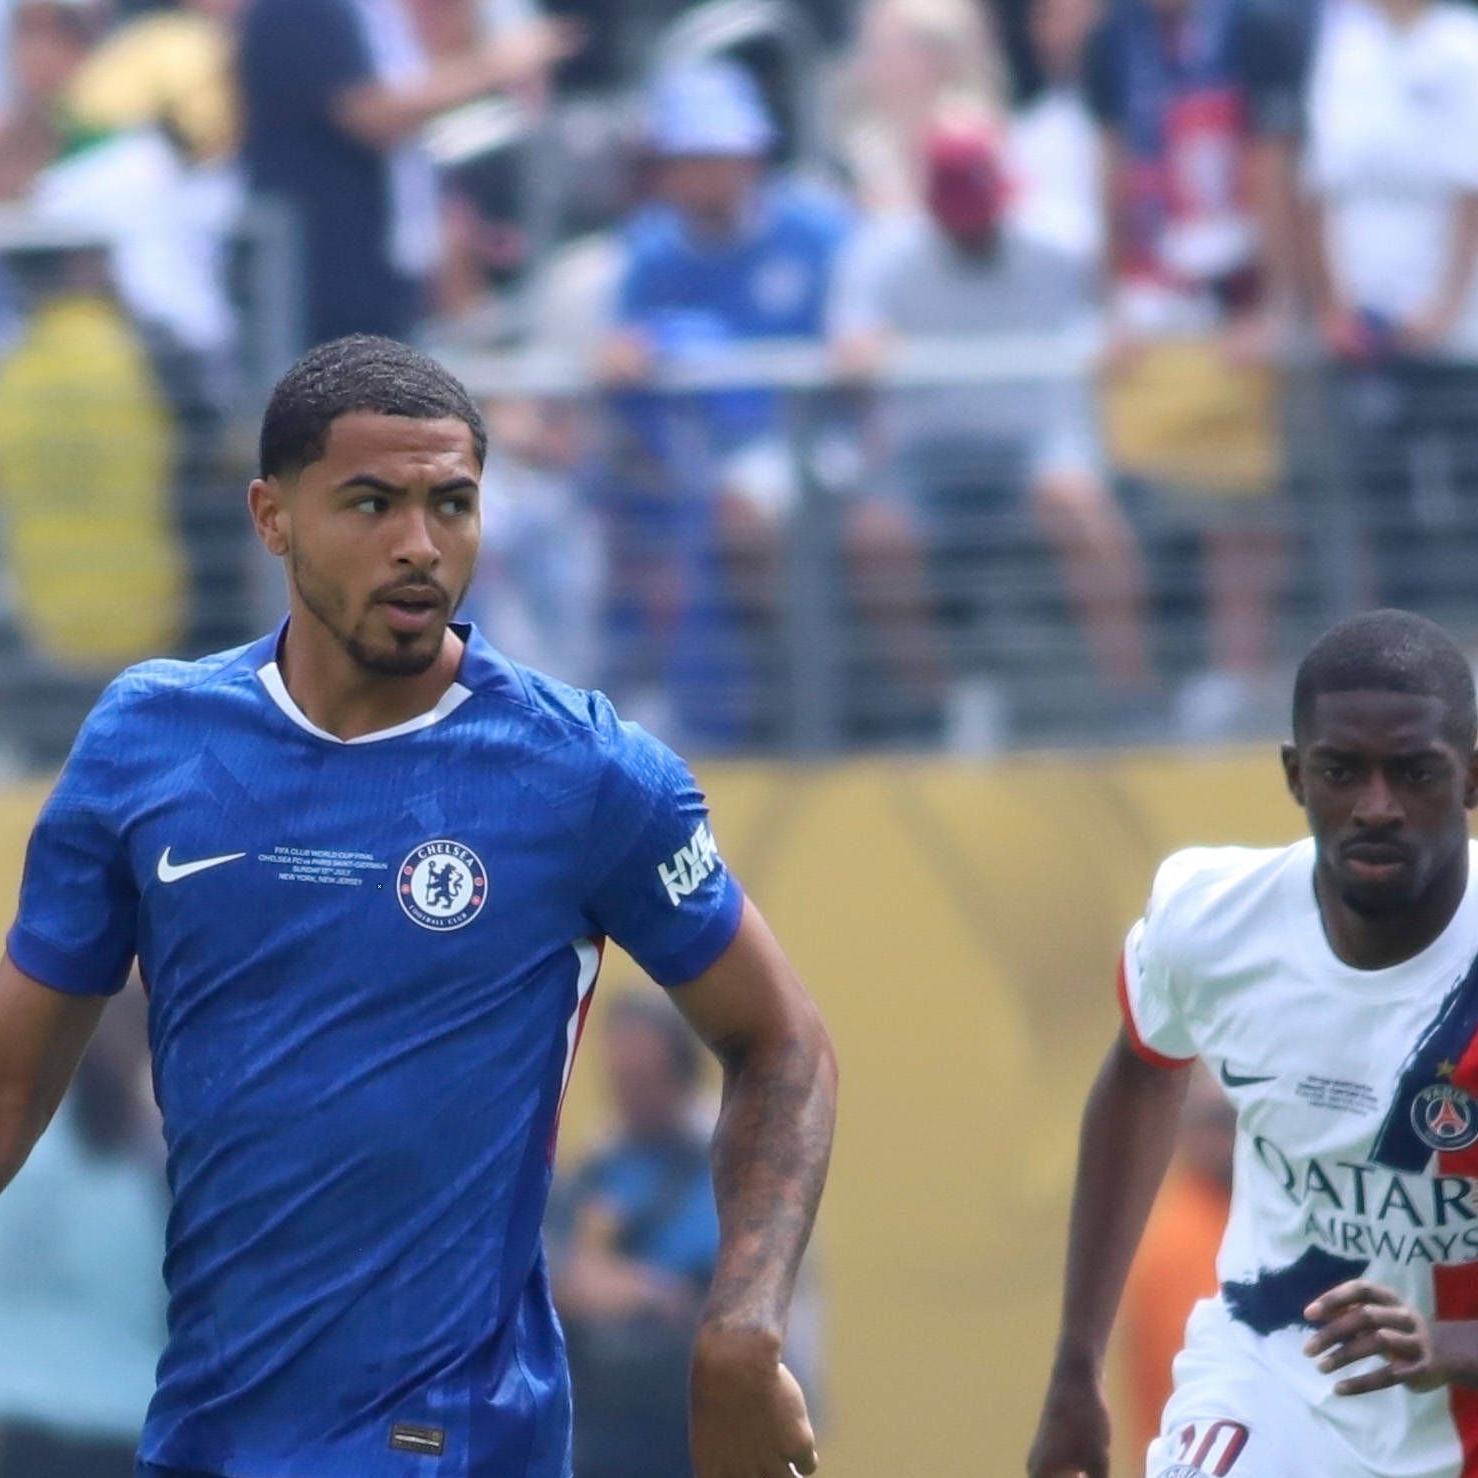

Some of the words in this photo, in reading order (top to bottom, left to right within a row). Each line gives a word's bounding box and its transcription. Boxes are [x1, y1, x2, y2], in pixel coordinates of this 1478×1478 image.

[258, 854, 291, 864] CHELSEA
[417, 843, 474, 868] CHELSEA
[1253, 1136, 1478, 1228] QATAR
